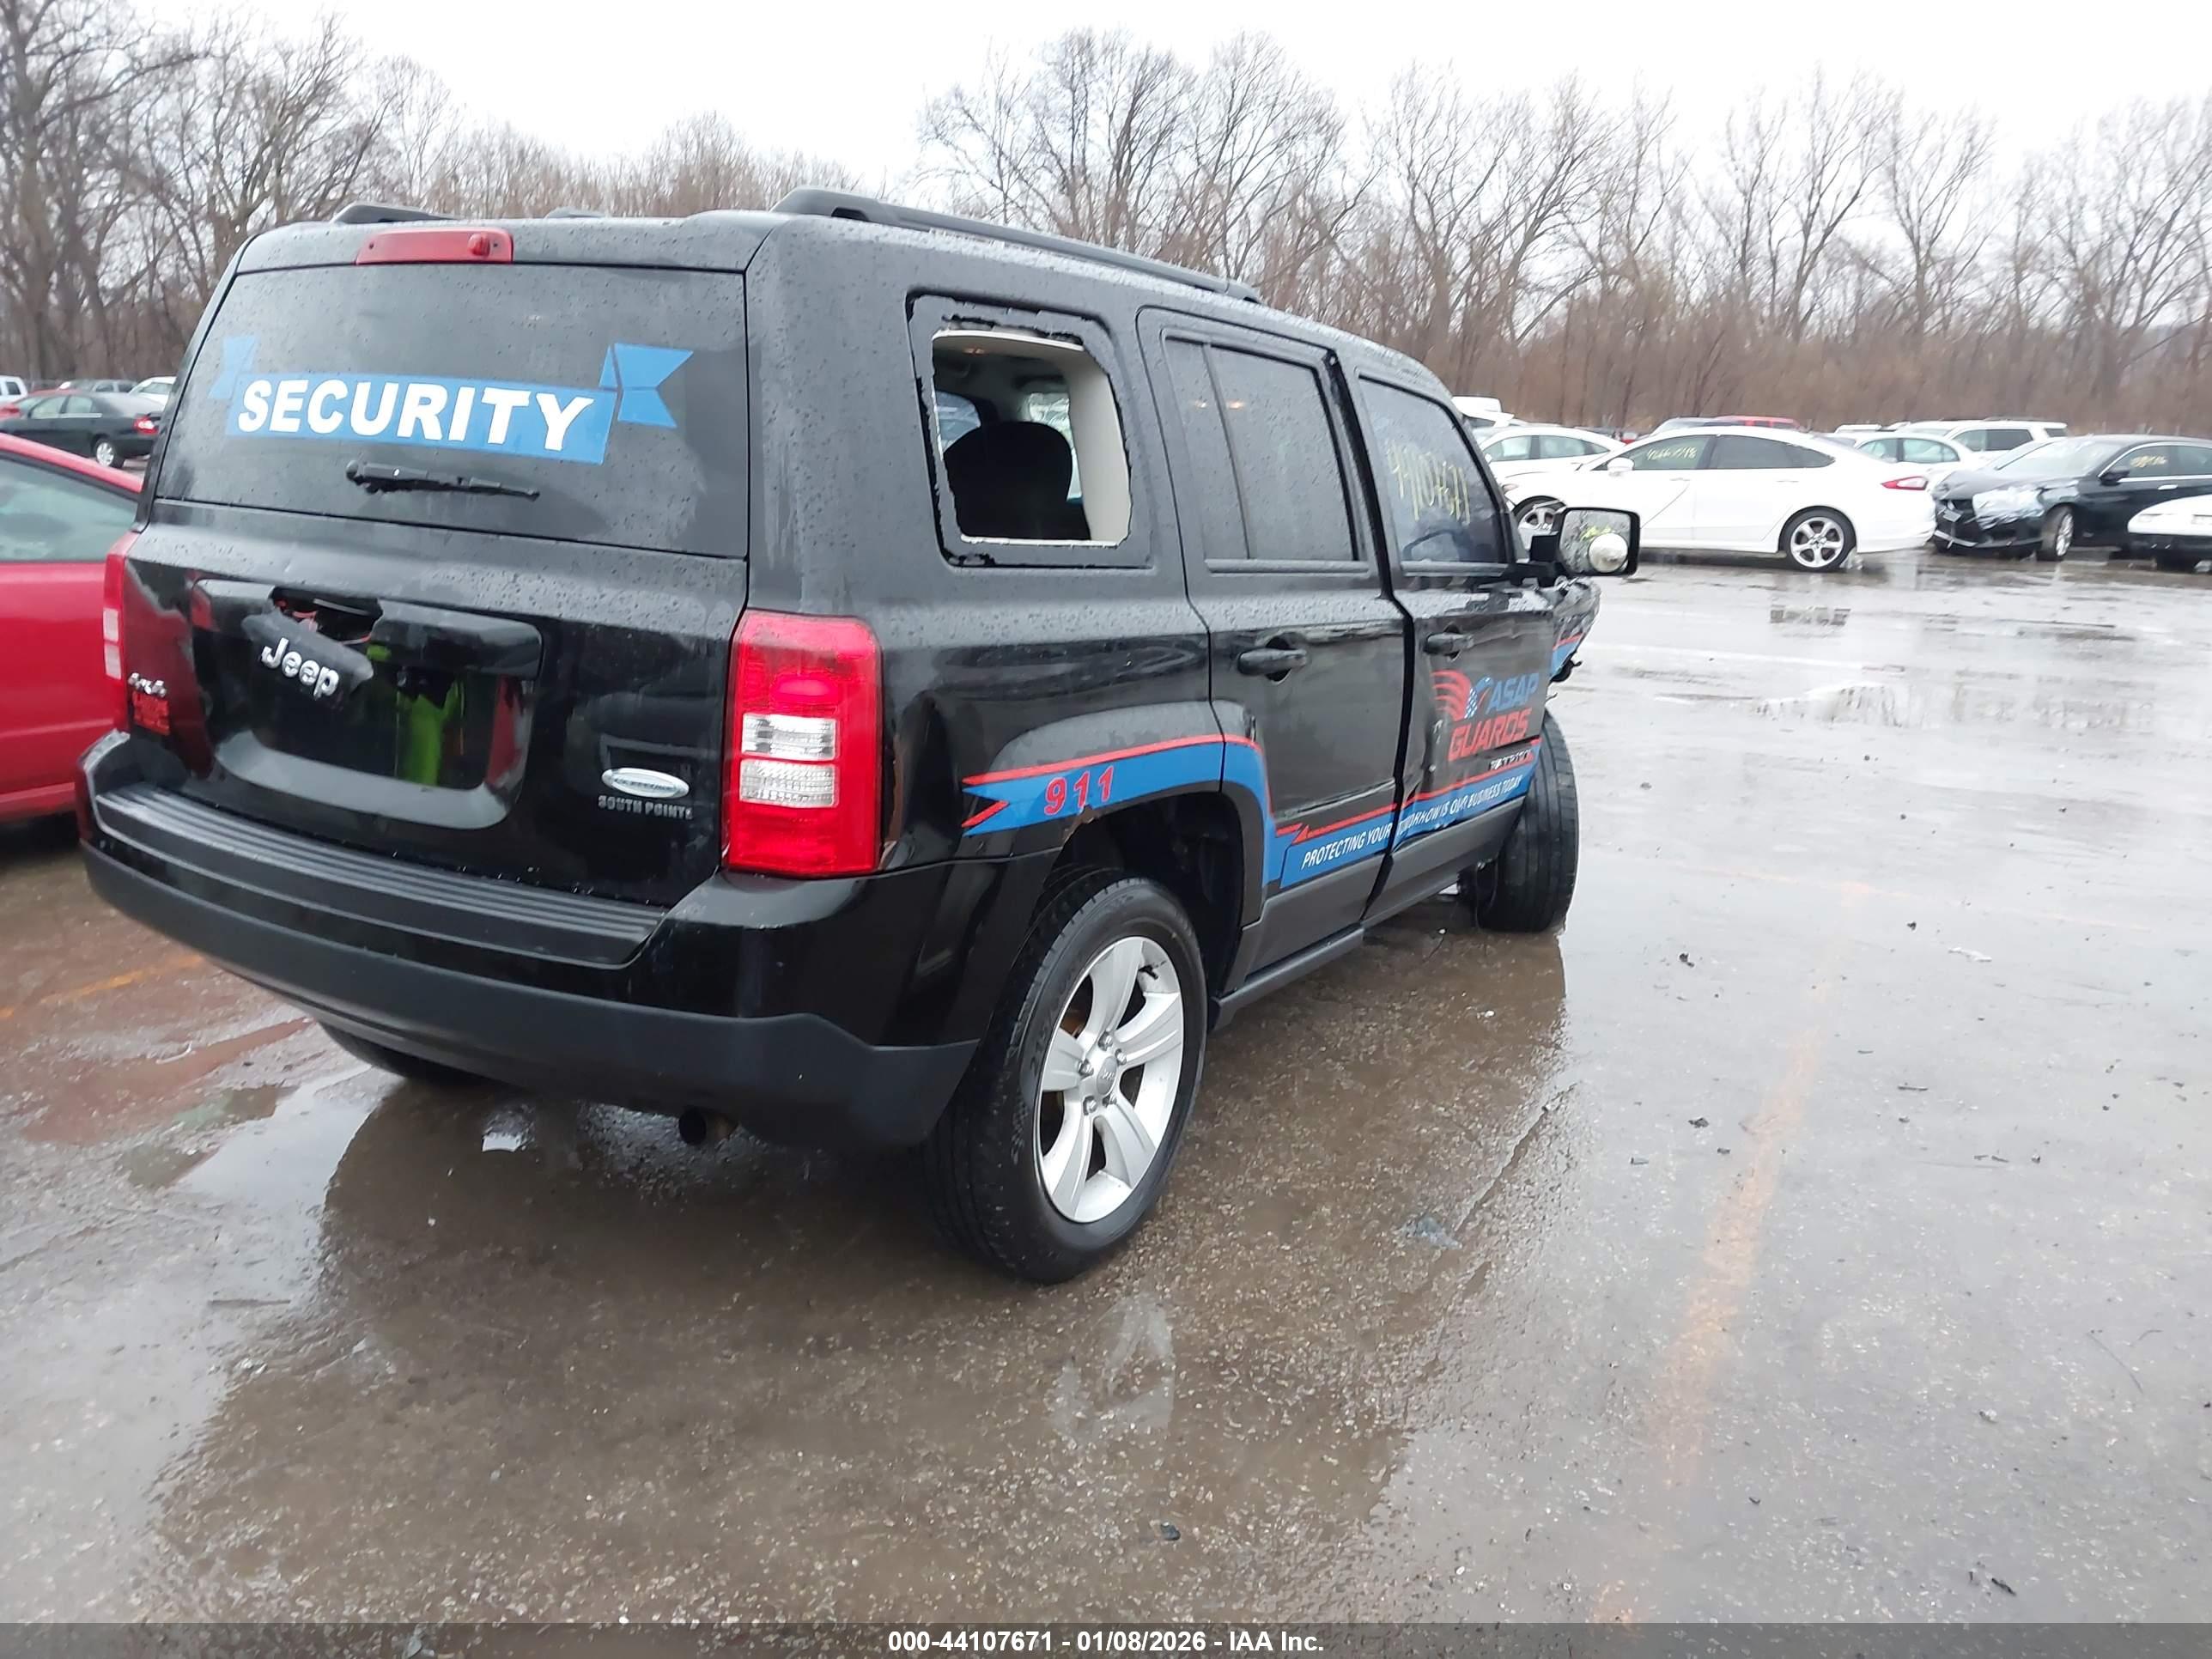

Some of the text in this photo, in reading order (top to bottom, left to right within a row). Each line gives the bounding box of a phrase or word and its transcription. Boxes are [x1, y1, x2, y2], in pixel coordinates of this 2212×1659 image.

[238, 379, 594, 452] SECURITY
[261, 637, 339, 701] Jeep
[1486, 673, 1540, 714] ASAP
[1448, 708, 1533, 763] GUARDS
[599, 795, 693, 820] SOUTH POINTE
[1043, 765, 1115, 816] 911
[1301, 831, 1367, 870] PROTECTING
[1366, 823, 1393, 845] YOUR
[1440, 800, 1450, 817] IS
